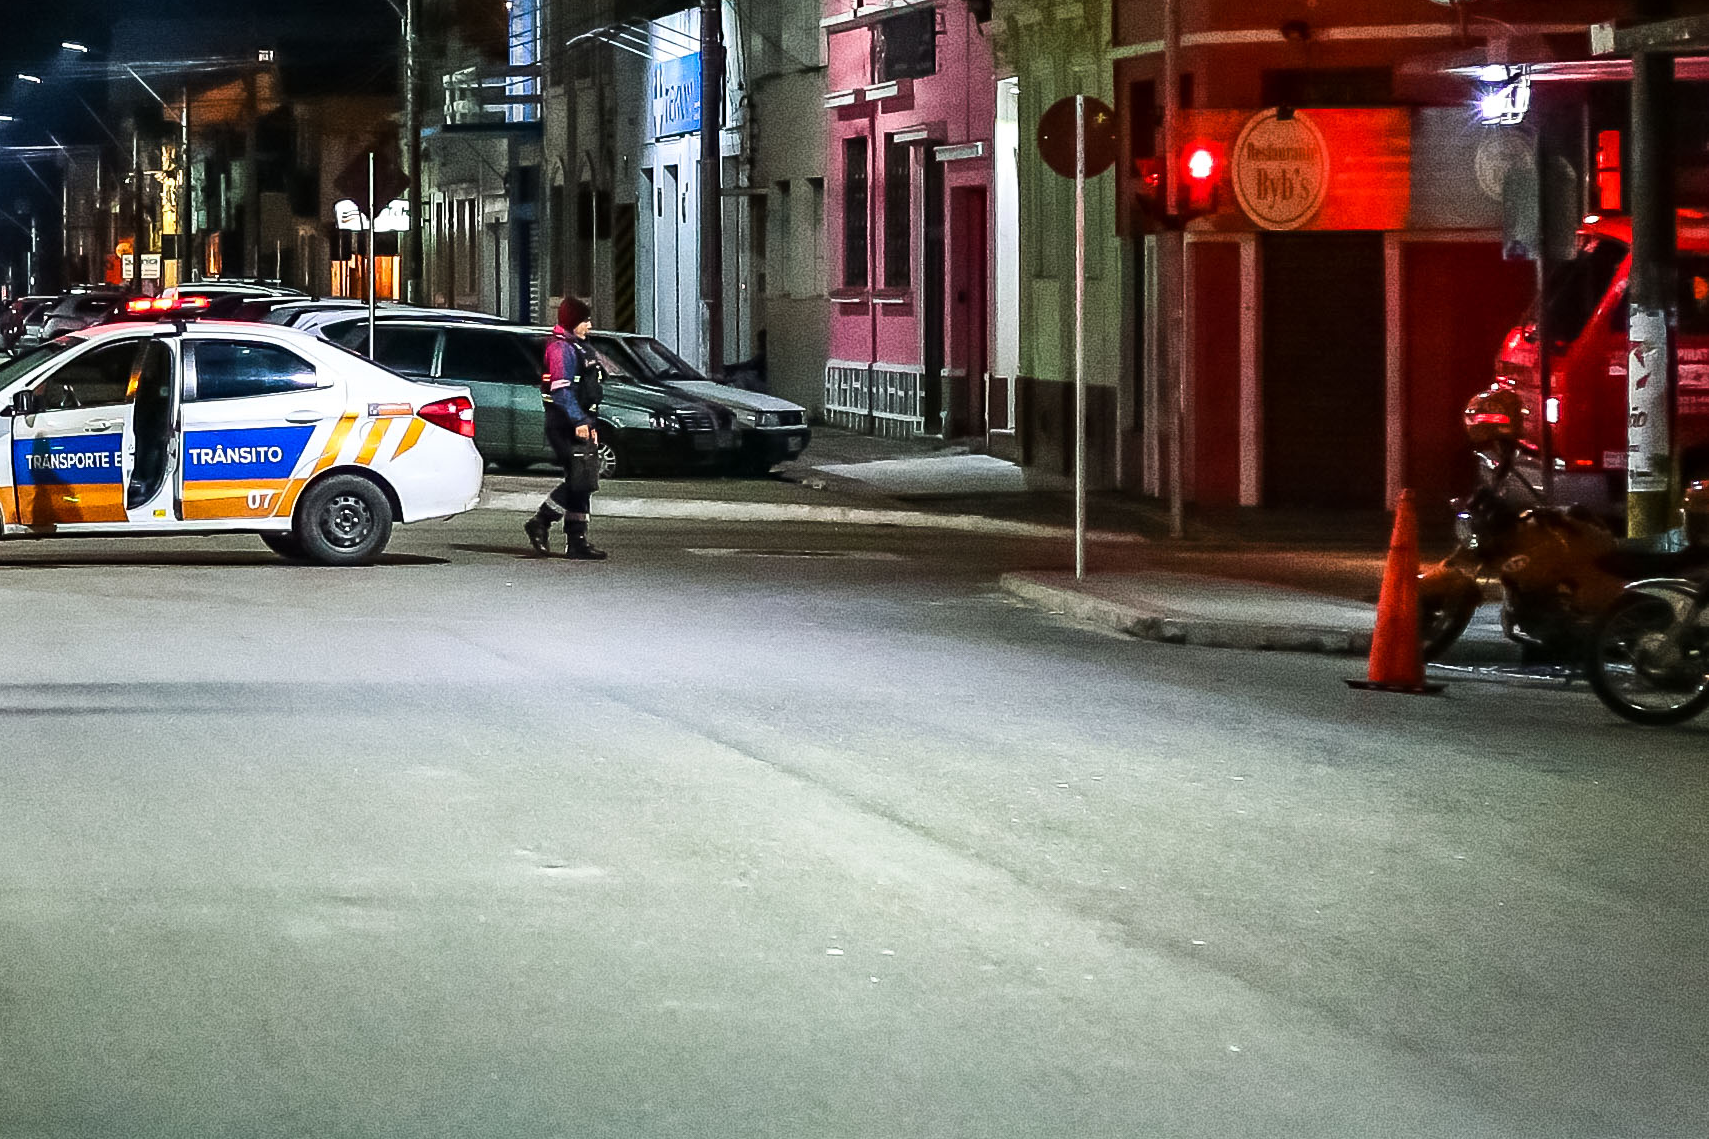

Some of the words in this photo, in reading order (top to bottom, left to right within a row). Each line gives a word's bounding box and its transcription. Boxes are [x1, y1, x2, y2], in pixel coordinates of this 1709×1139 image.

[25, 452, 109, 470] TRANSPORTE
[114, 452, 122, 467] E
[189, 444, 283, 465] TRÂNSITO
[247, 489, 276, 510] 07
